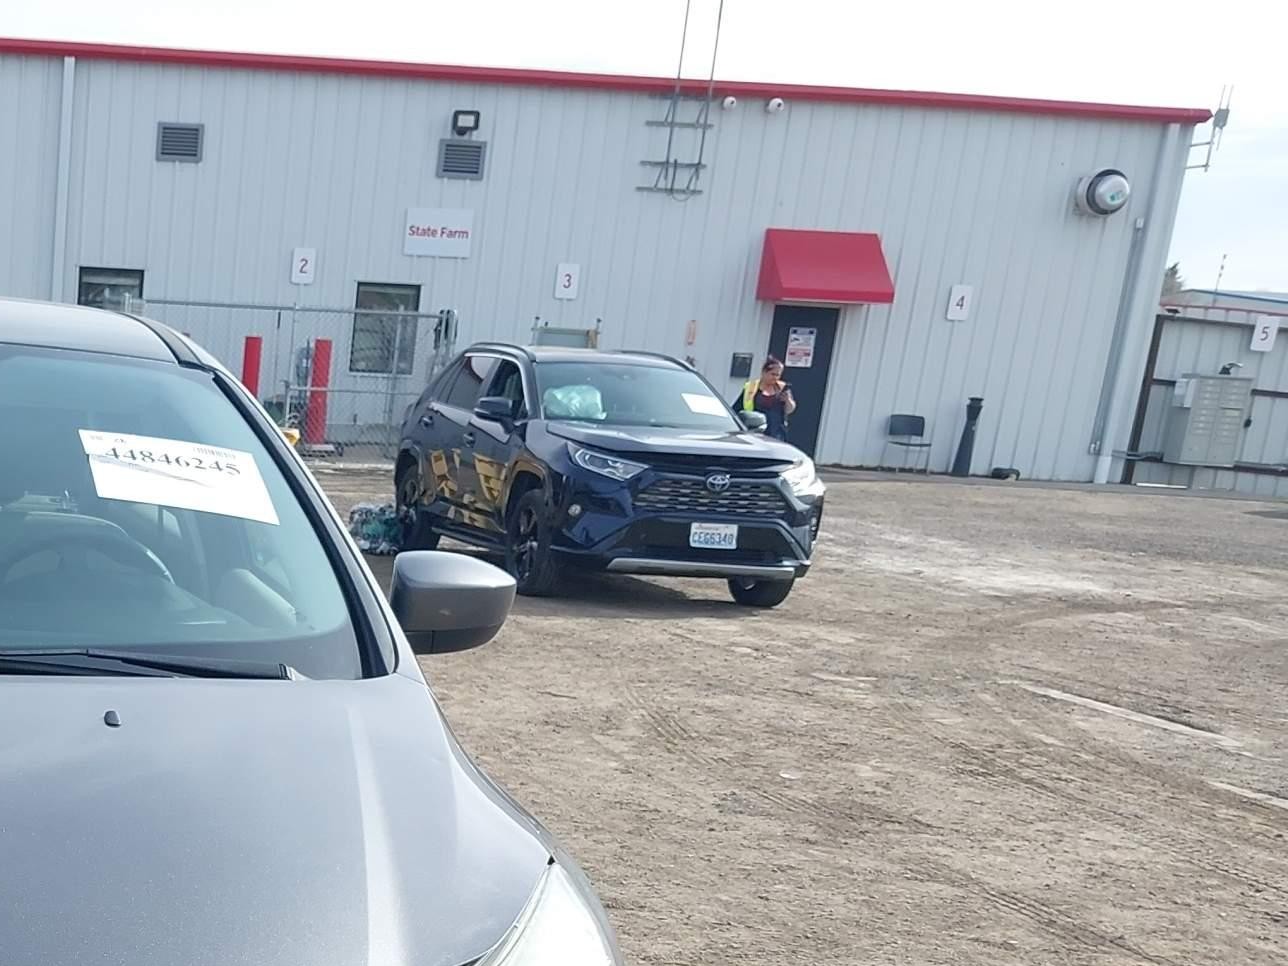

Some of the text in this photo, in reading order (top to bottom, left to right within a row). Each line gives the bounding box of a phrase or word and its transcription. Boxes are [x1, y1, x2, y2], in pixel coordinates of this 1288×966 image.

[408, 225, 469, 239] State Farm
[298, 257, 309, 274] 2
[562, 273, 572, 289] 3
[955, 295, 965, 310] 4
[1259, 326, 1270, 341] 5
[105, 447, 241, 476] 44846245
